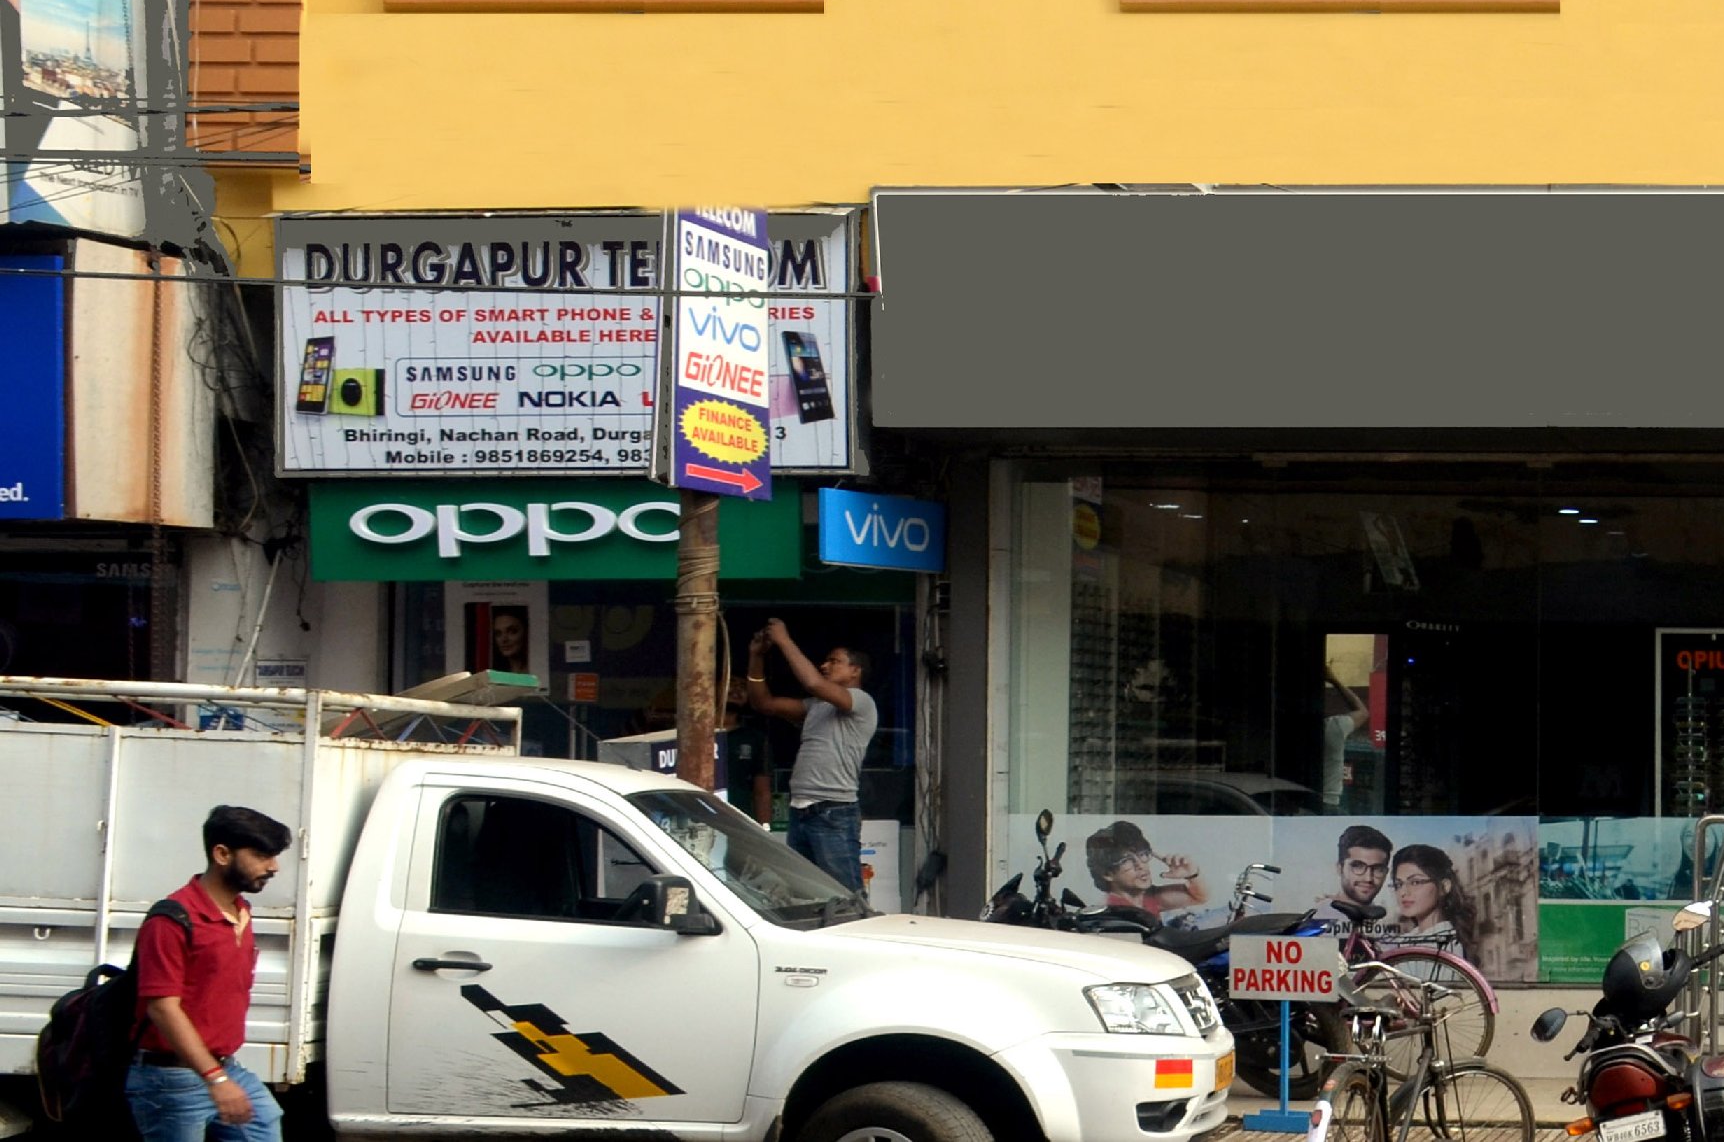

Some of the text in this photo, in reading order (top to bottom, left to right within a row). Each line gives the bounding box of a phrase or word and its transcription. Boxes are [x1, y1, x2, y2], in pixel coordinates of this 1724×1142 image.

[685, 230, 765, 281] SAMSUNG
[304, 241, 589, 293] DURGAPUR
[314, 311, 354, 323] ALL
[362, 310, 432, 323] TYPES
[439, 310, 466, 323] OF
[474, 309, 549, 323] SMART
[557, 308, 631, 321] PHONE
[638, 308, 655, 320] &
[472, 330, 657, 344] AVAILABLE HERE
[406, 365, 517, 382] SAMSUNG
[518, 390, 620, 407] NOKIA
[699, 407, 752, 433] FINANCE
[344, 428, 432, 445] Bhiringi,
[440, 428, 518, 442] Nachan
[527, 428, 585, 443] Road,
[692, 426, 759, 454] AVAILABLE
[385, 450, 454, 464] Mobile
[475, 449, 609, 465] 9851869254,
[1266, 941, 1303, 965] NO
[1233, 967, 1333, 994] PARKING
[1634, 1120, 1661, 1137] 6563
